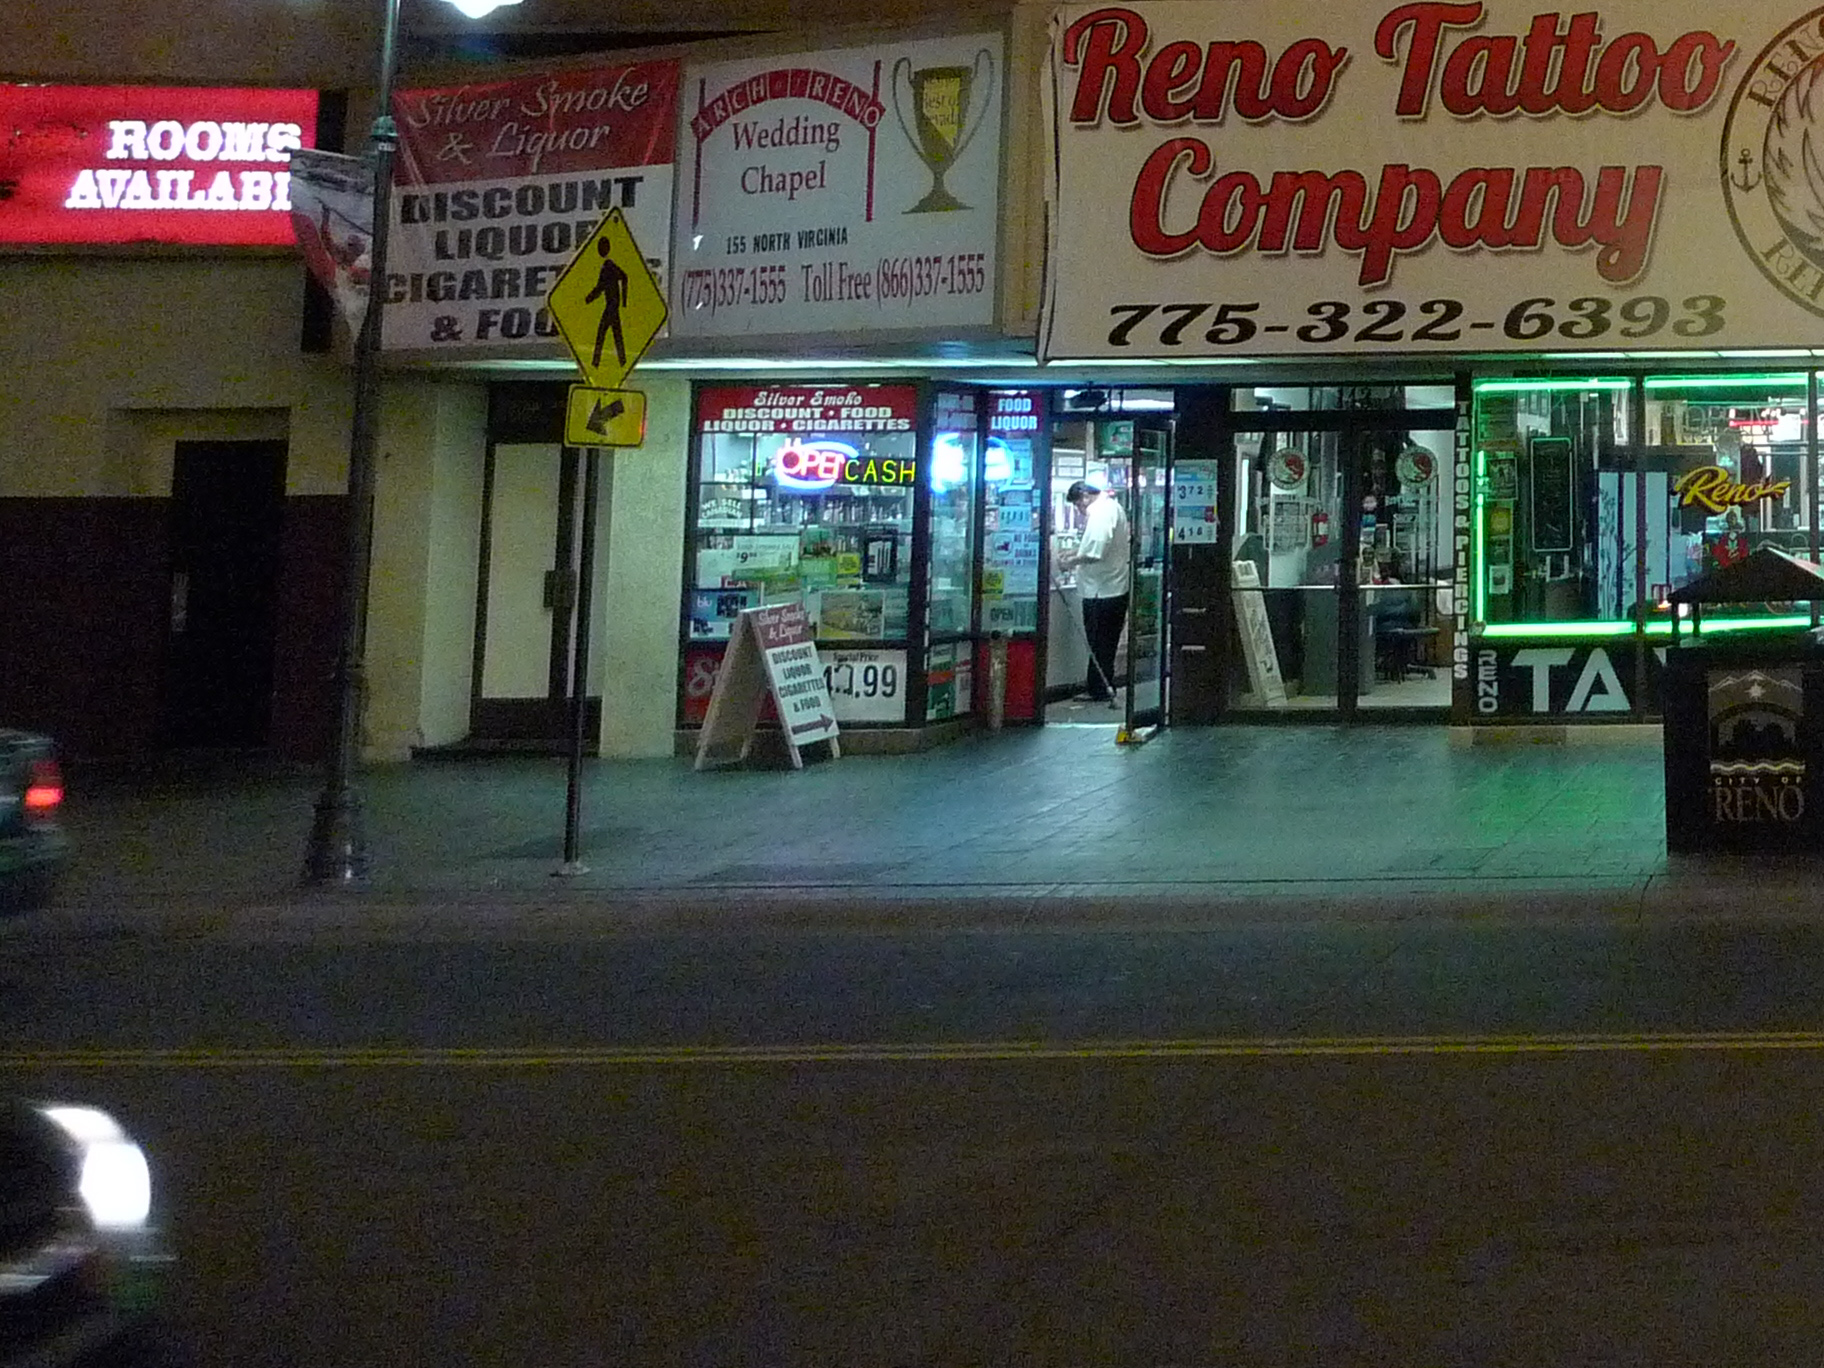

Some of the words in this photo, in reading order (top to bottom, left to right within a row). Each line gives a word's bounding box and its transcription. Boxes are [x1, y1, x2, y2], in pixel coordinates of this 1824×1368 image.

[1063, 6, 1349, 126] Reno
[1373, 0, 1738, 119] Tattoo
[405, 85, 511, 129] Silver
[520, 66, 649, 118] Smoke
[812, 75, 882, 129] RENO
[106, 120, 302, 162] ROOMS
[436, 132, 475, 165] &
[484, 120, 612, 175] Liquor
[731, 115, 841, 153] Wedding
[740, 160, 827, 201] Chapel
[400, 175, 645, 225] DISCOUNT
[1128, 136, 1667, 290] Company
[726, 236, 746, 255] 155
[753, 233, 790, 254] NORTH
[798, 226, 848, 250] VIRGINIA
[681, 264, 787, 319] (775)337-1555
[801, 262, 834, 303] Toll
[837, 260, 872, 302] Free
[876, 252, 986, 311] (866)337-1555
[429, 315, 463, 343] &
[475, 307, 560, 340] FOO
[1106, 295, 1728, 348] 775-322-6393
[723, 408, 823, 419] DISCOUNT
[840, 407, 893, 419] FOOD
[753, 390, 804, 406] Silver
[810, 390, 863, 406] Smoke
[998, 398, 1032, 413] FOOD
[703, 420, 775, 431] LIQUOR
[792, 419, 911, 431] CIGARETTES
[991, 415, 1038, 431] LIQUOR
[844, 459, 916, 483] CASH
[1455, 401, 1470, 510] TATTOOS
[1672, 465, 1792, 513] Reno
[771, 645, 813, 665] DISCOUNT
[782, 663, 813, 680] LIQUOR
[778, 677, 826, 699] CIGARETTES
[1477, 649, 1499, 714] RENO
[800, 695, 822, 711] FOOD
[1714, 785, 1806, 823] RENO
